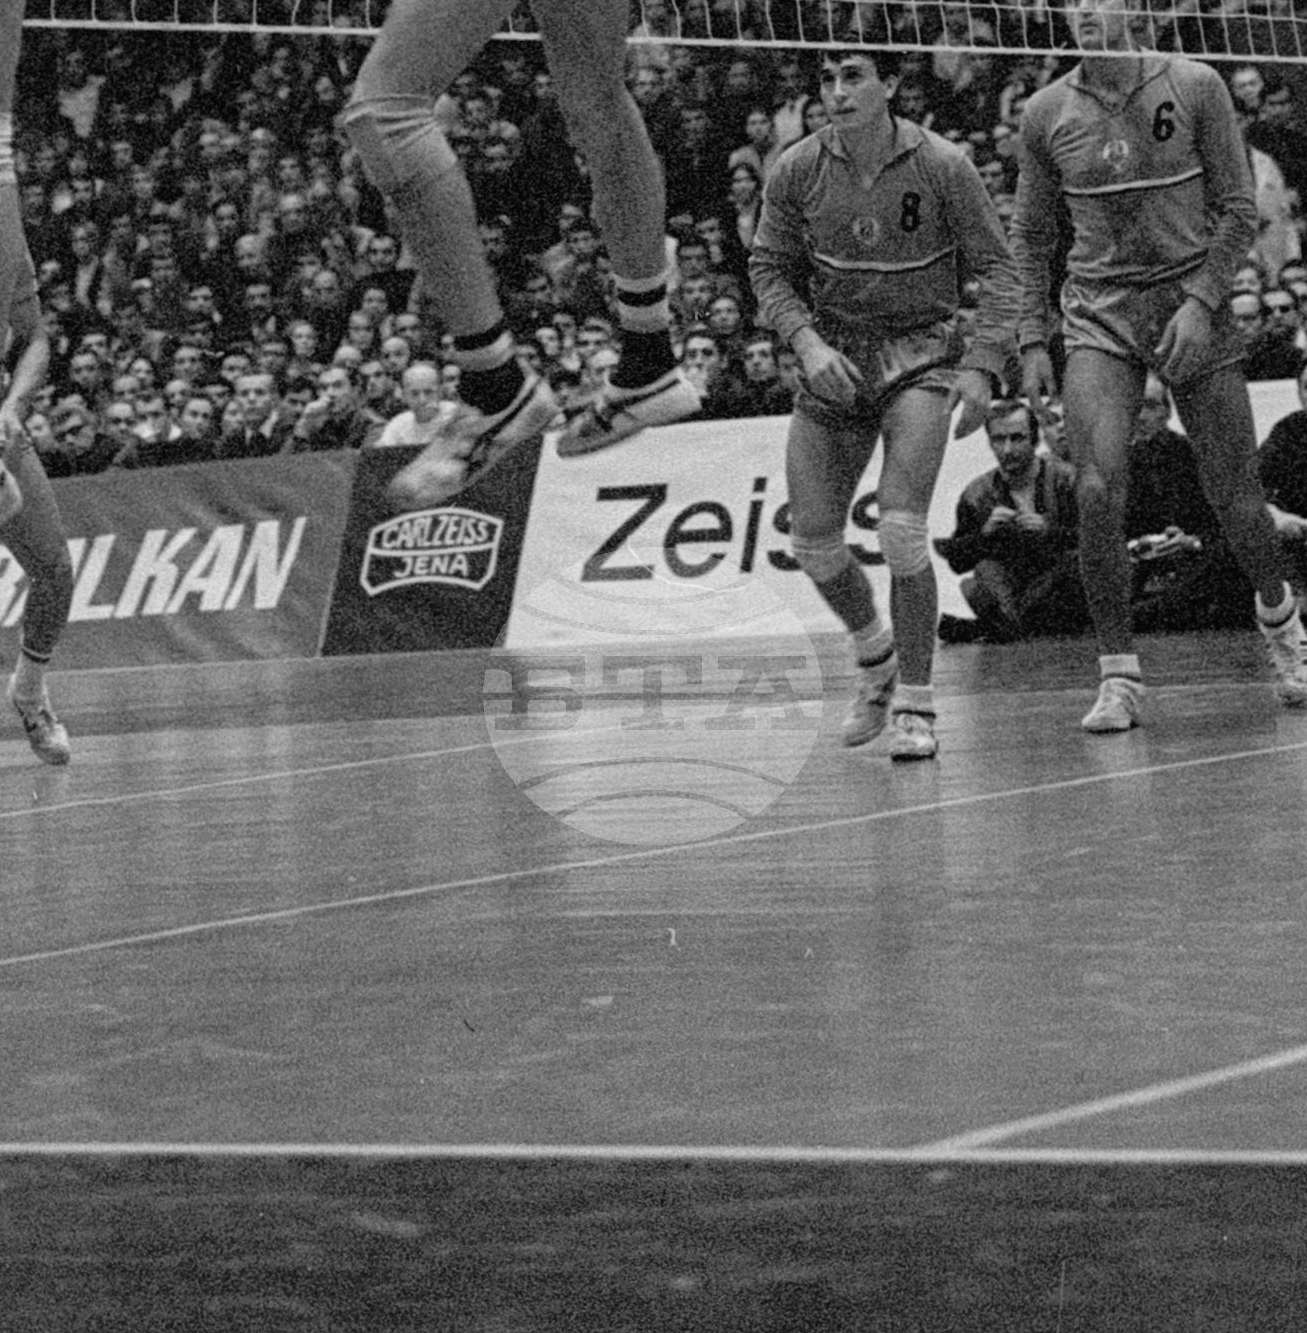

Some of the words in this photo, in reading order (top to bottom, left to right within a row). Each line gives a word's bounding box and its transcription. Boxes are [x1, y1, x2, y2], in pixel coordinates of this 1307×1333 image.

[1152, 101, 1176, 142] 6
[900, 191, 921, 233] 8
[394, 553, 469, 578] JENA
